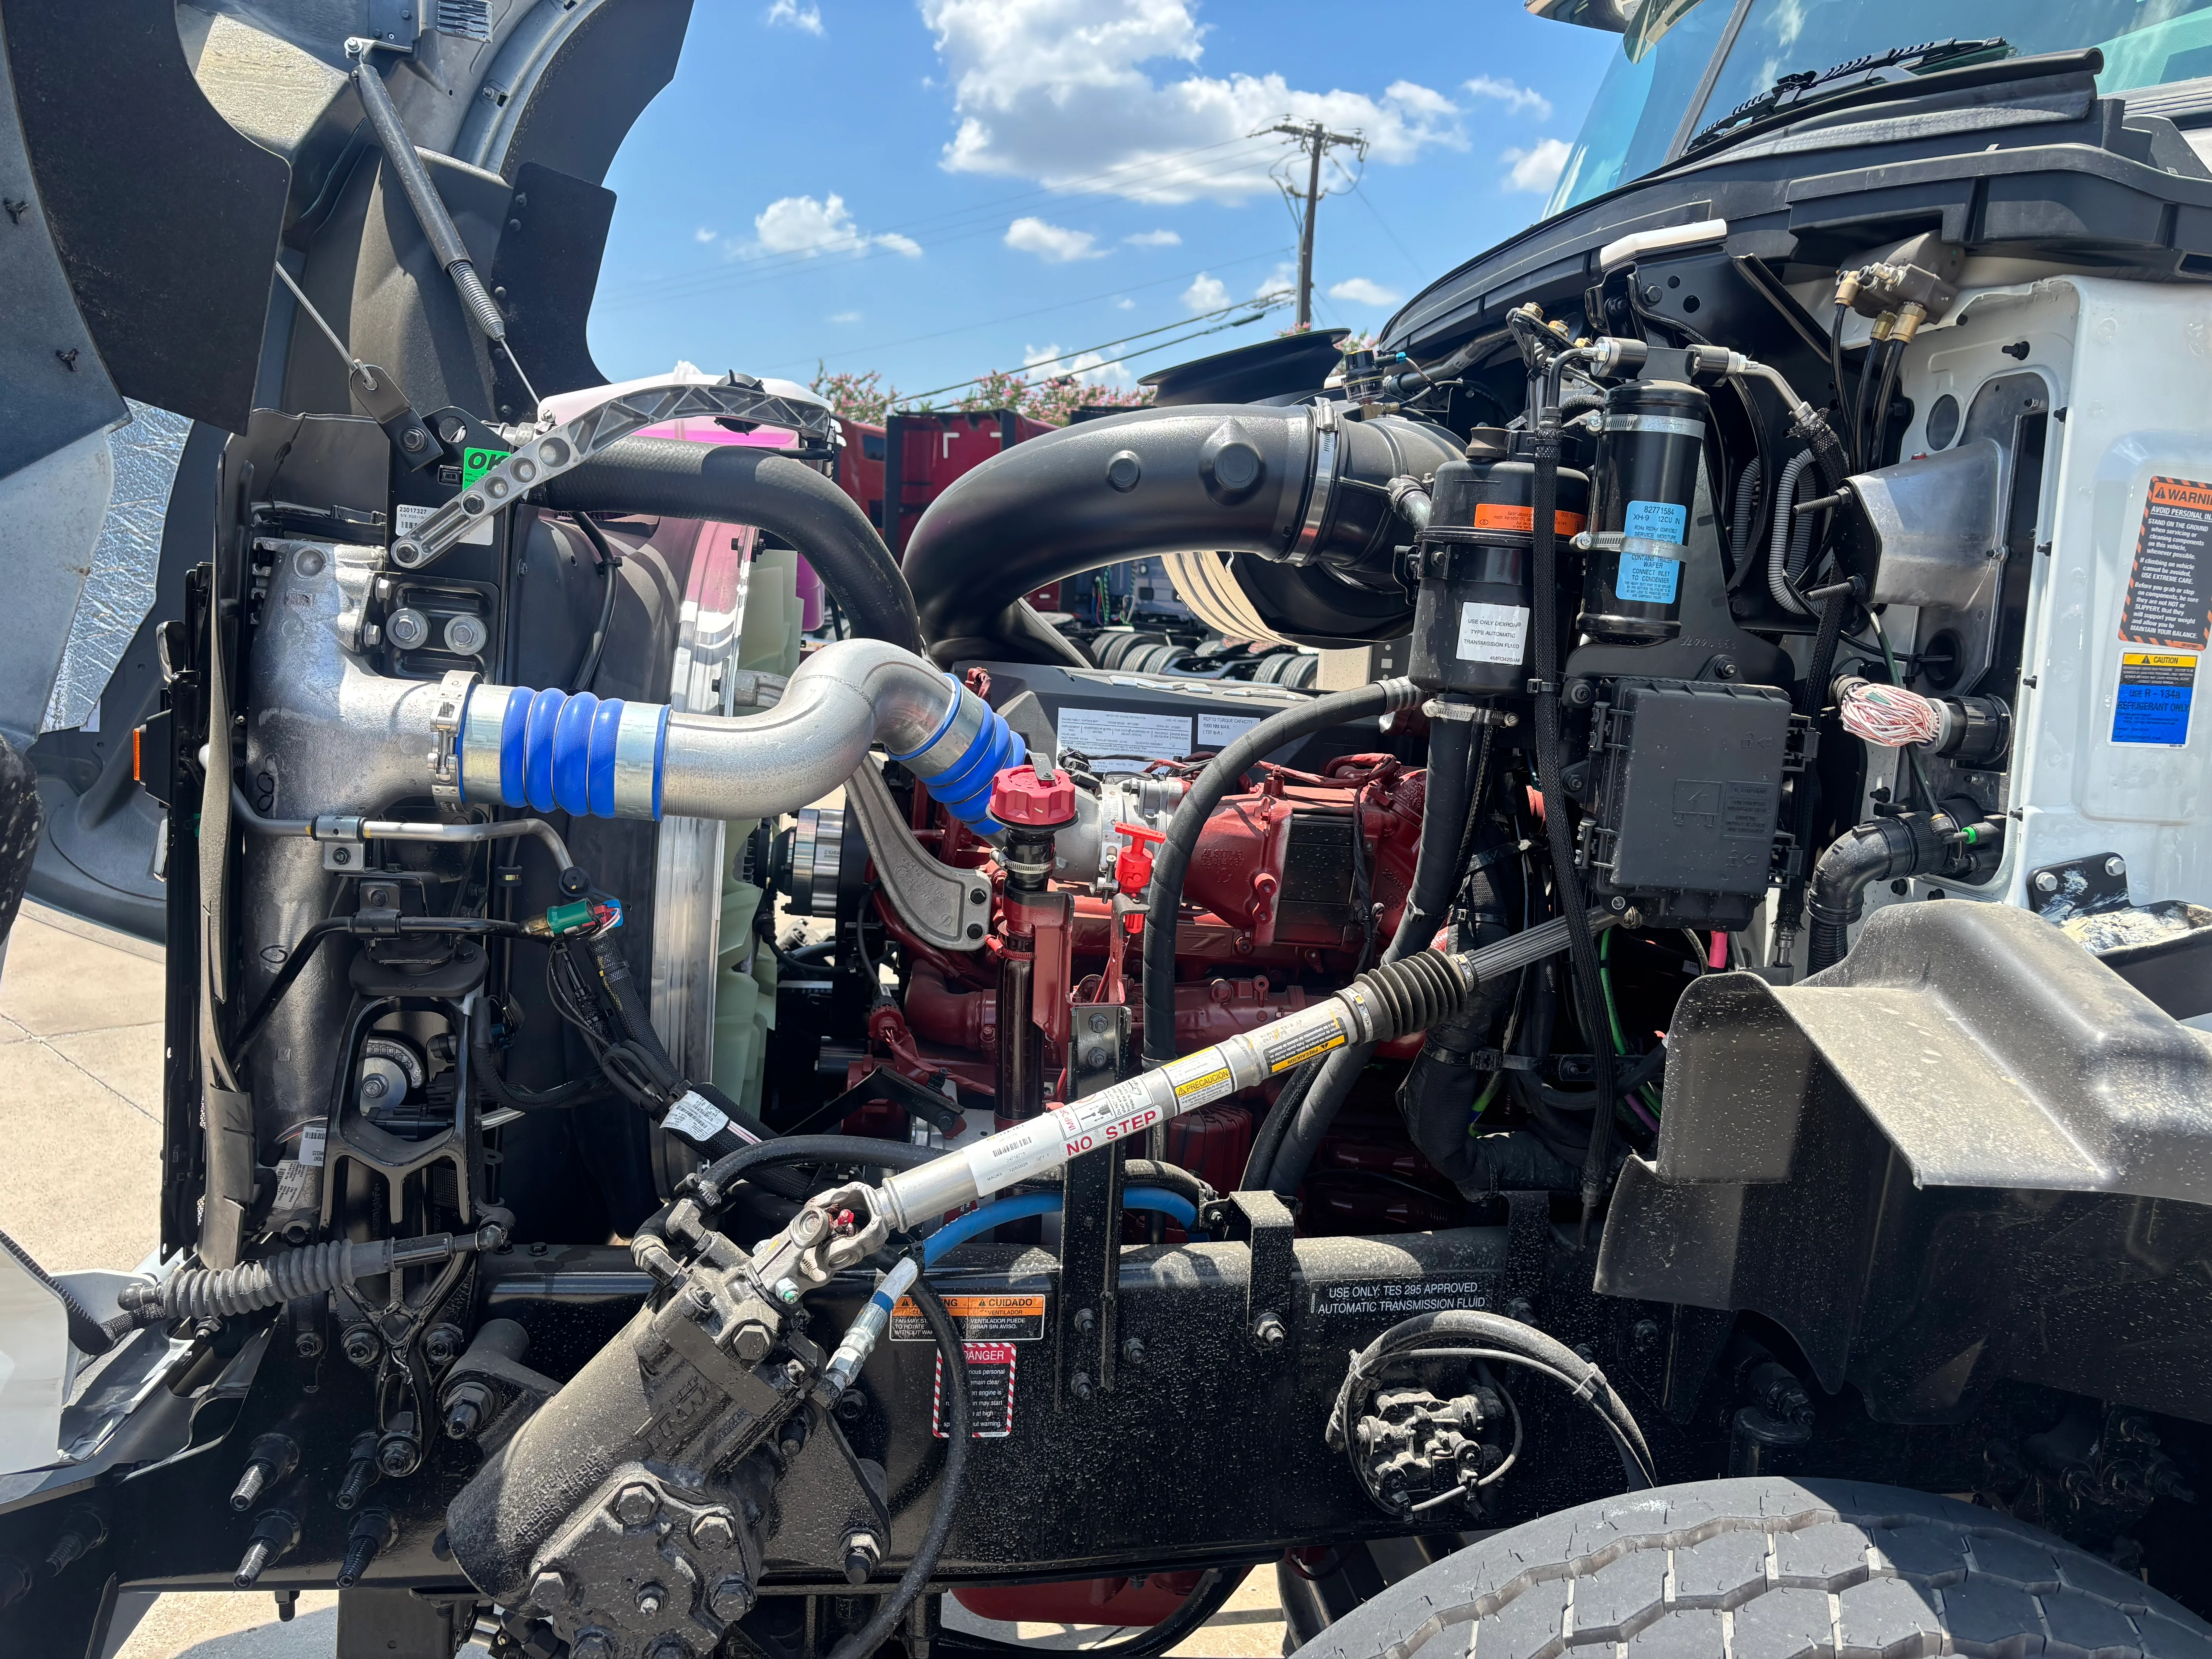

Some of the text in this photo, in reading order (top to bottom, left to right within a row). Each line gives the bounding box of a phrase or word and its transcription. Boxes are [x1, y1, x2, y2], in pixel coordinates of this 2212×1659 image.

[468, 452, 509, 471] OK
[2169, 489, 2212, 505] WARNI
[1644, 506, 1674, 515] 82771584
[2151, 506, 2170, 514] AVOID
[2171, 509, 2202, 519] PERSONAL
[2167, 529, 2190, 537] servicing
[2150, 534, 2171, 542] cleaning
[2145, 558, 2167, 567] climbing
[2153, 574, 2177, 582] EXTREME
[2145, 592, 2178, 601] components,
[2135, 604, 2160, 613] SLIPPERY,
[2130, 625, 2156, 634] MAINTAIN
[1464, 639, 1503, 647] TRANSMISSION
[2160, 690, 2181, 699] 134a
[2118, 701, 2189, 712] REFRIGERANT ONLY
[931, 887, 948, 904] USA
[1186, 1072, 1228, 1092] PRECAUCIÓN
[1066, 1110, 1156, 1157] NO STEP
[1329, 1282, 1478, 1298] USE ONLY: TES 295 APPROVED
[1317, 1297, 1485, 1314] AUTOMATIC TRANSMISSION FLUID
